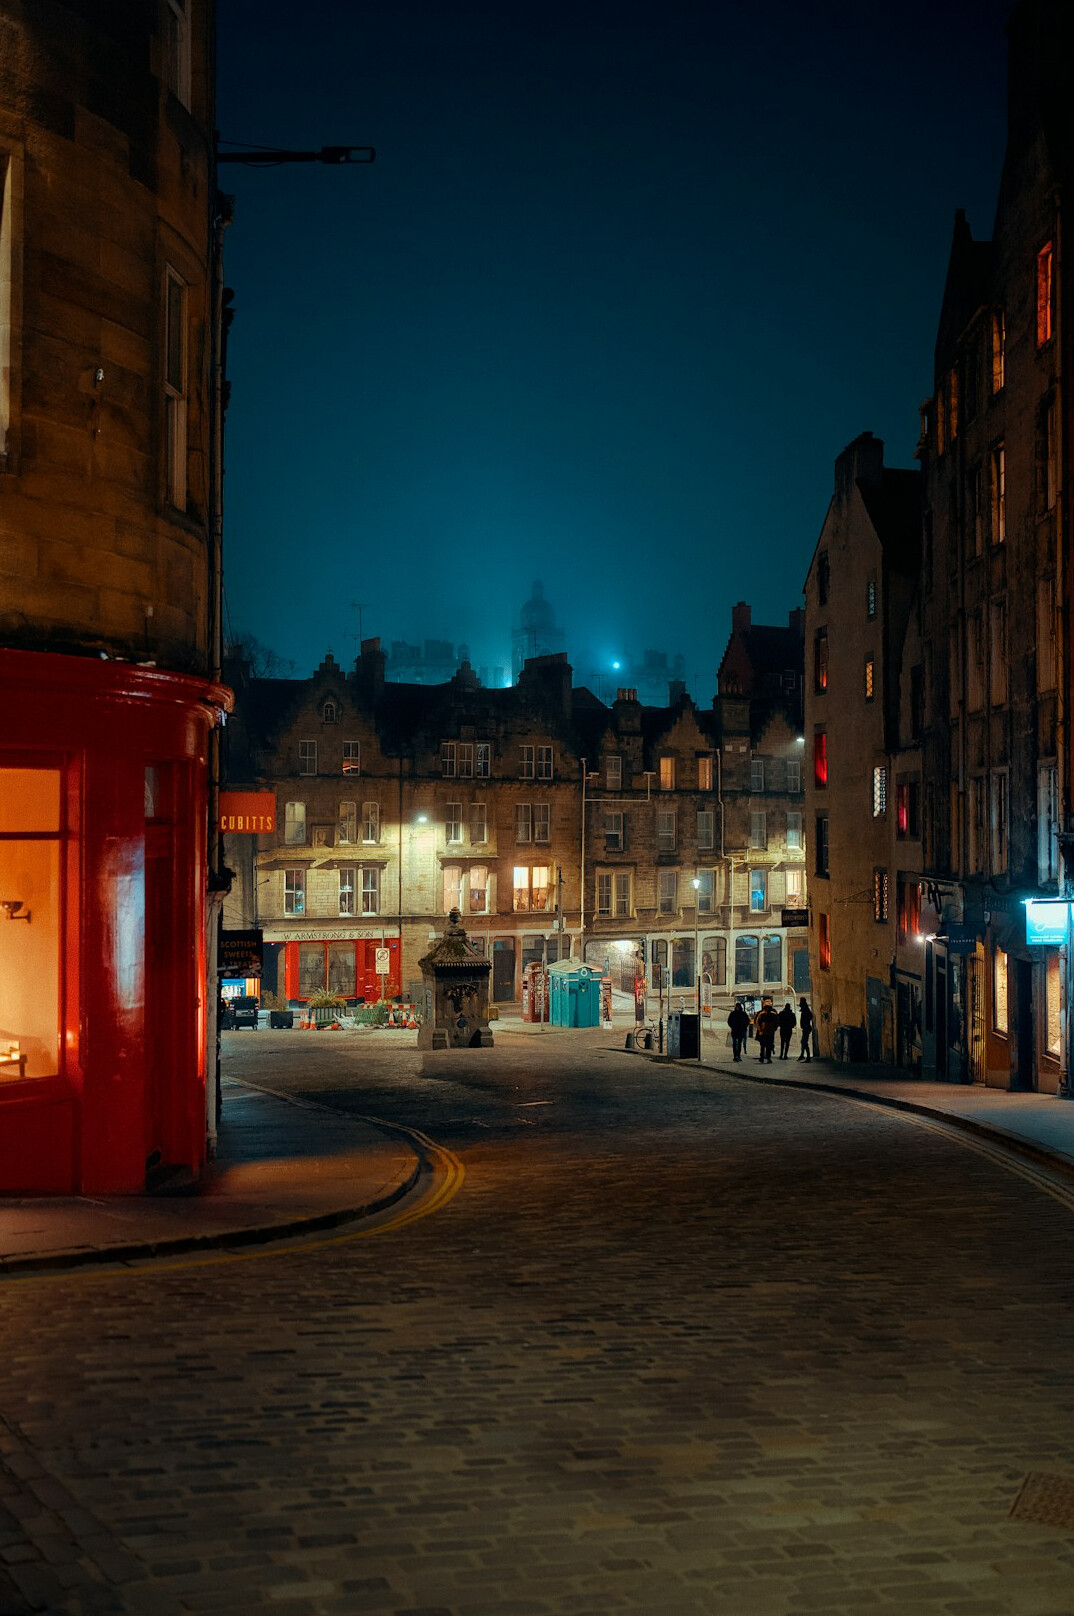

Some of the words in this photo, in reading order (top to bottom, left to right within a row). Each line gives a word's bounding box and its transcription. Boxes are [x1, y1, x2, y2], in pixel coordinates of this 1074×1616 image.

[221, 815, 272, 830] CUBITTS
[295, 931, 346, 940] ARMSTRONG
[349, 931, 355, 939] &
[357, 930, 374, 938] SON
[220, 940, 257, 948] SCOTTISH
[223, 950, 253, 958] SWEETS
